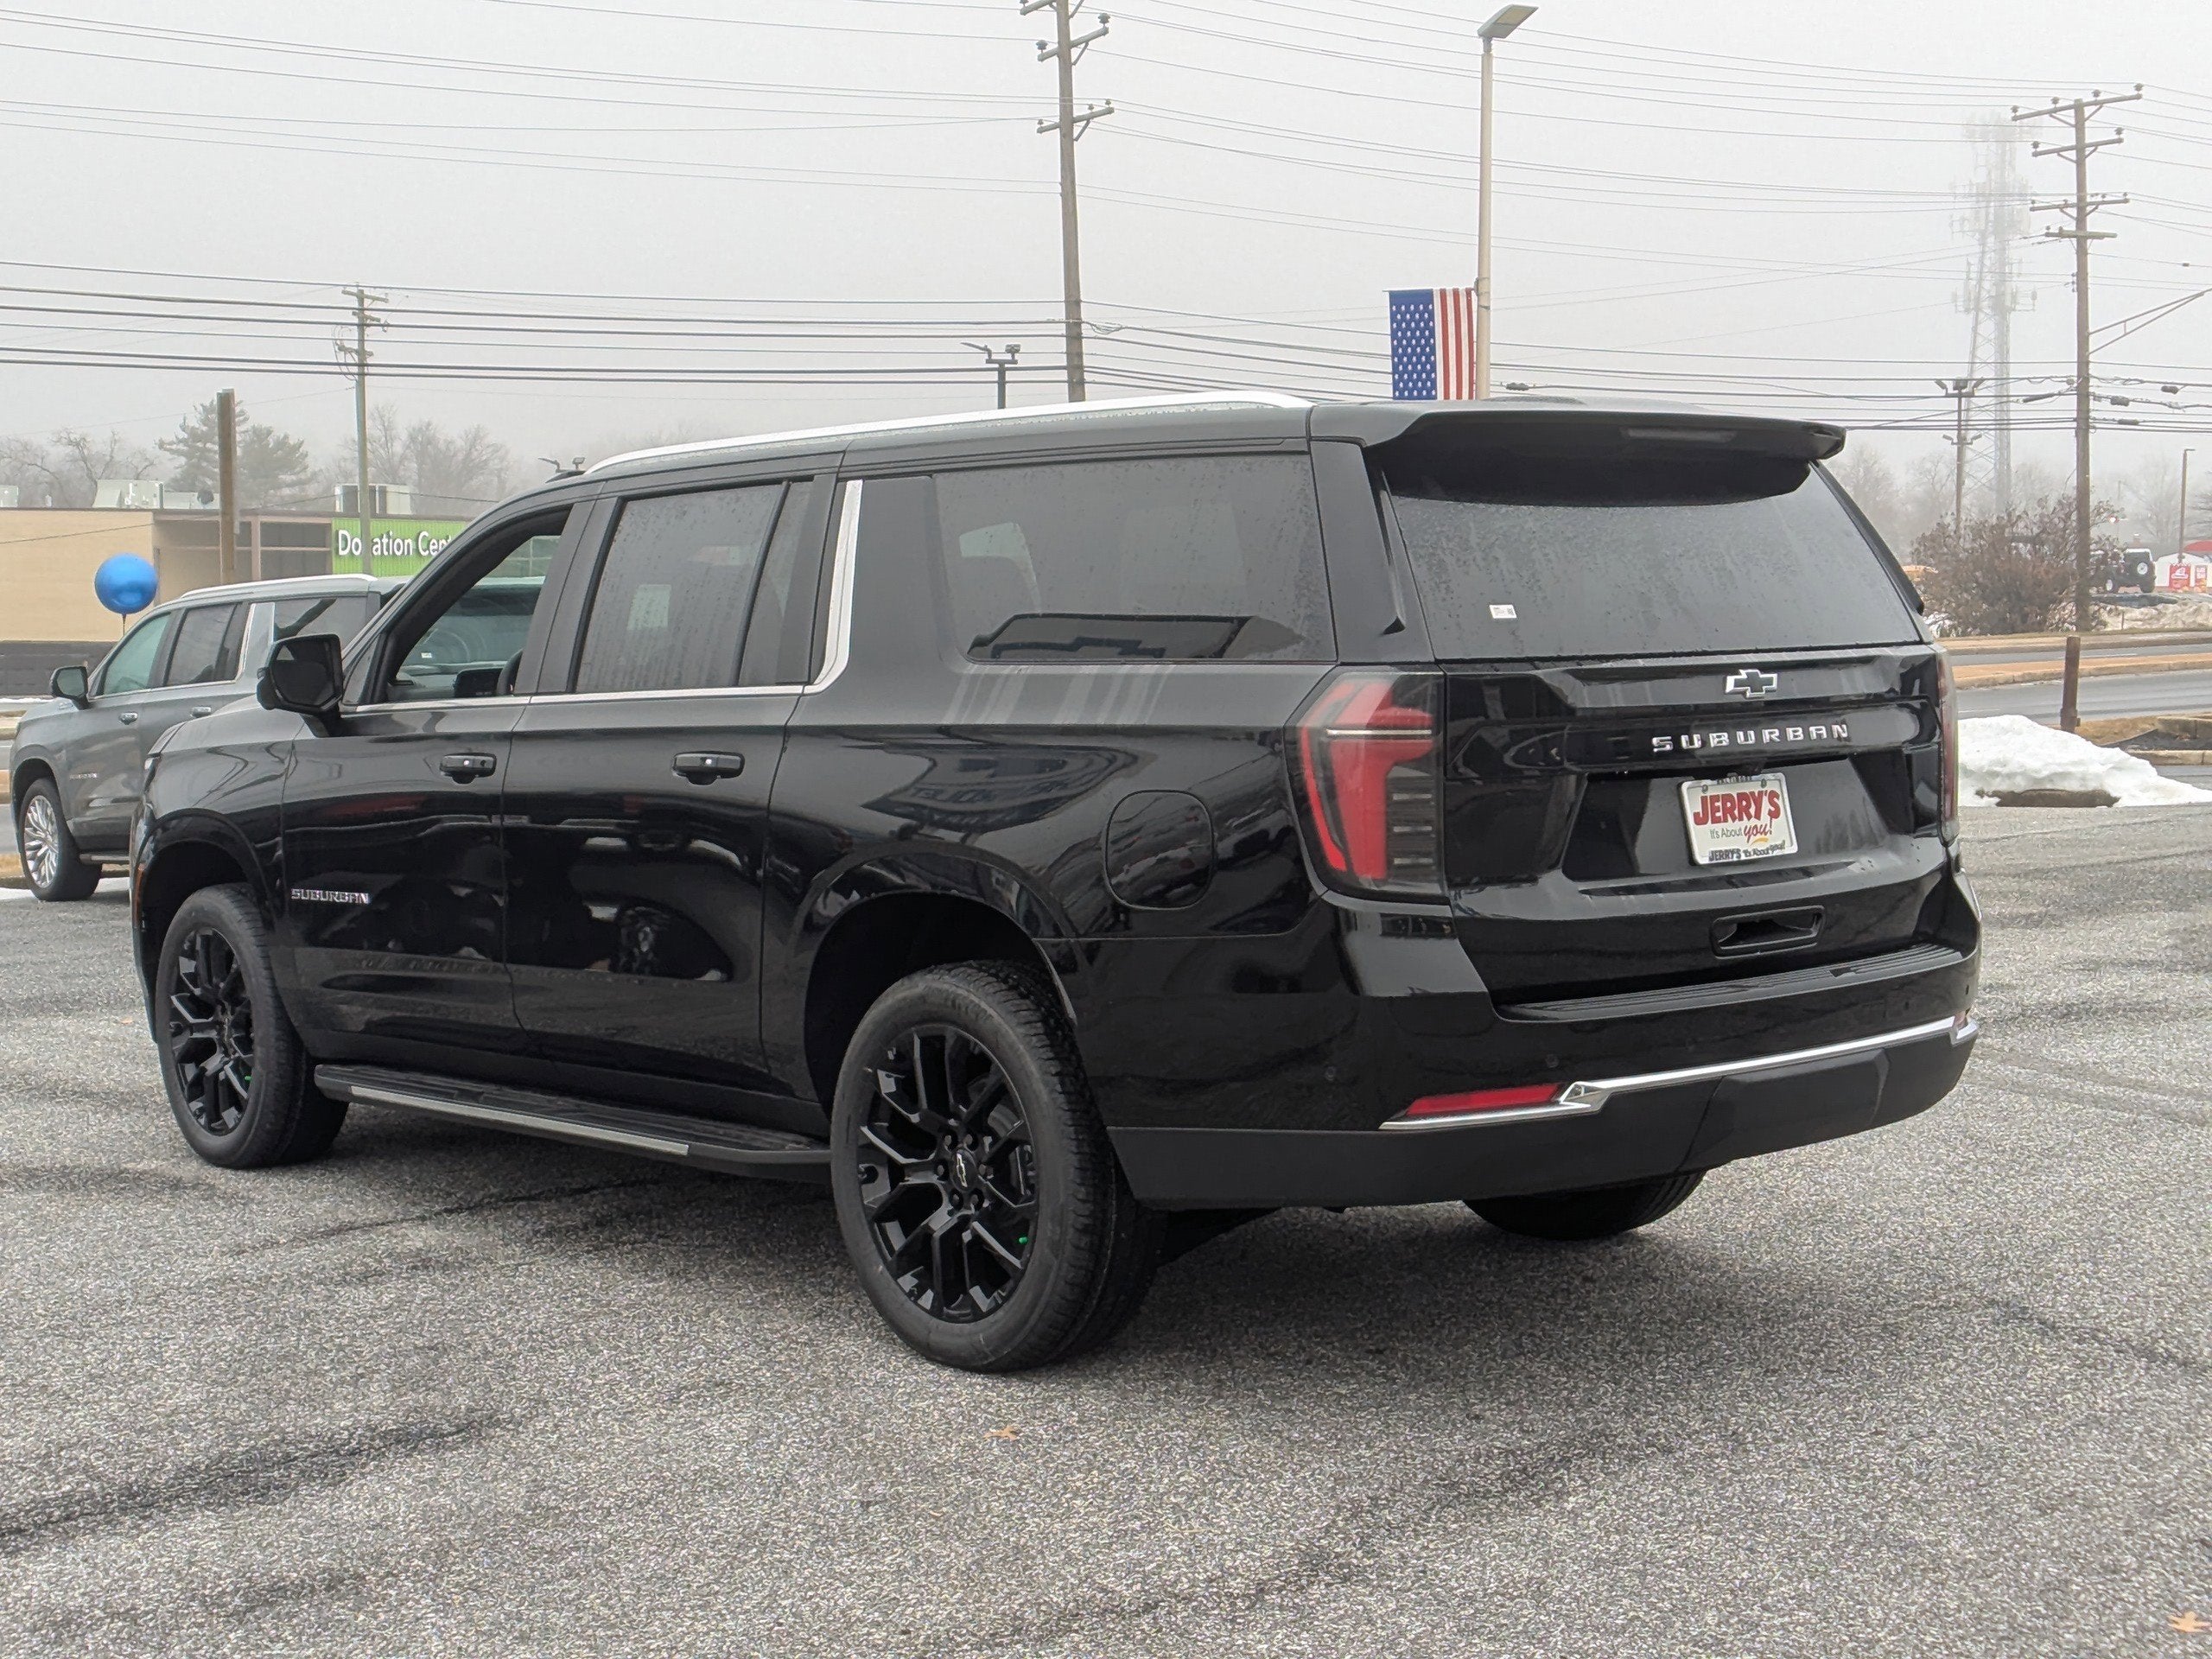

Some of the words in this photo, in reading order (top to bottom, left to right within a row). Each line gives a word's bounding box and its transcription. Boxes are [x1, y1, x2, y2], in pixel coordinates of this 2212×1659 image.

[337, 529, 413, 556] Doation
[1652, 724, 1849, 753] SUBURBAN
[1694, 790, 1781, 826] JERRY'S
[1720, 827, 1743, 838] About
[291, 888, 371, 905] SUBURBAN
